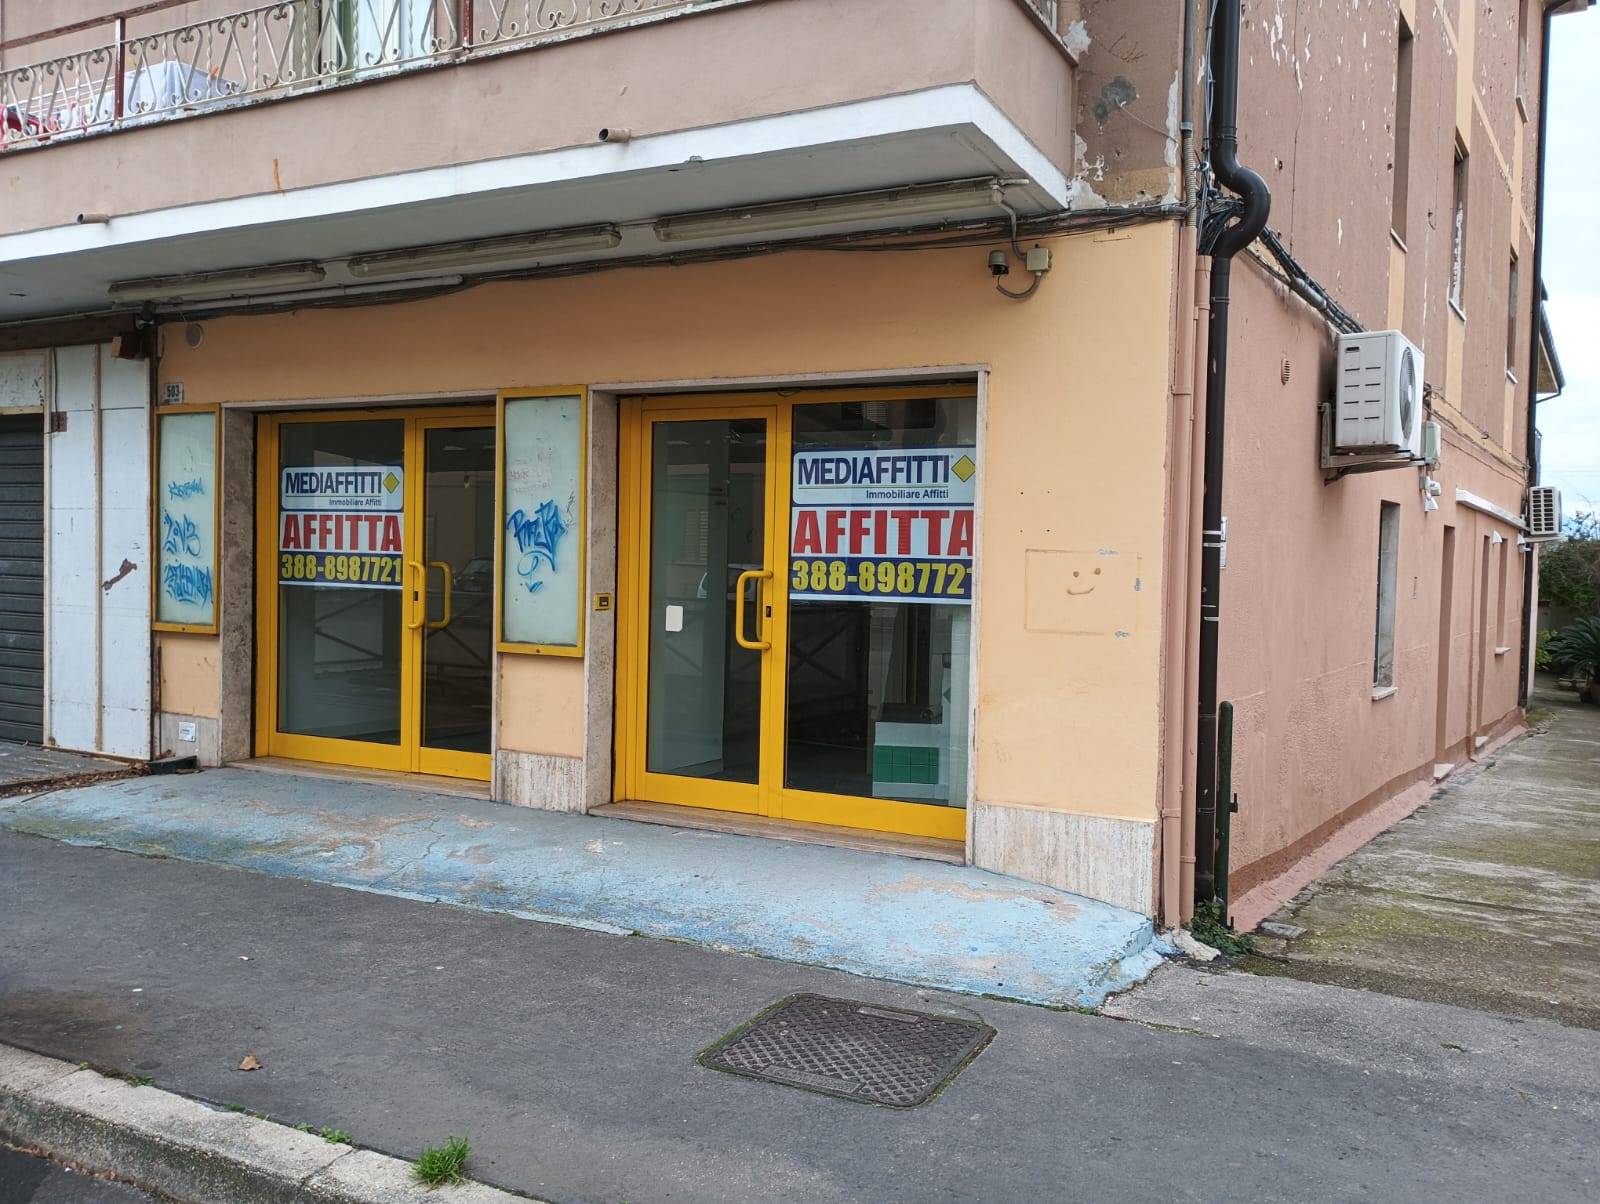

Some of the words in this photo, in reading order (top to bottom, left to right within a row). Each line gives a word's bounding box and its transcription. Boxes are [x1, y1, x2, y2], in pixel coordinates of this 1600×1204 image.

[285, 471, 382, 494] MEDIAFFITTI
[798, 455, 950, 485] MEDIAFFITTI
[329, 498, 363, 506] Immobiliare
[364, 498, 382, 506] Affitti
[866, 489, 920, 499] Immobiliare
[922, 489, 949, 499] Affitti
[281, 514, 402, 552] AFFITTA
[792, 510, 973, 556] AFFITTA
[281, 554, 401, 583] 388-8987721
[792, 560, 972, 595] 388-898772
